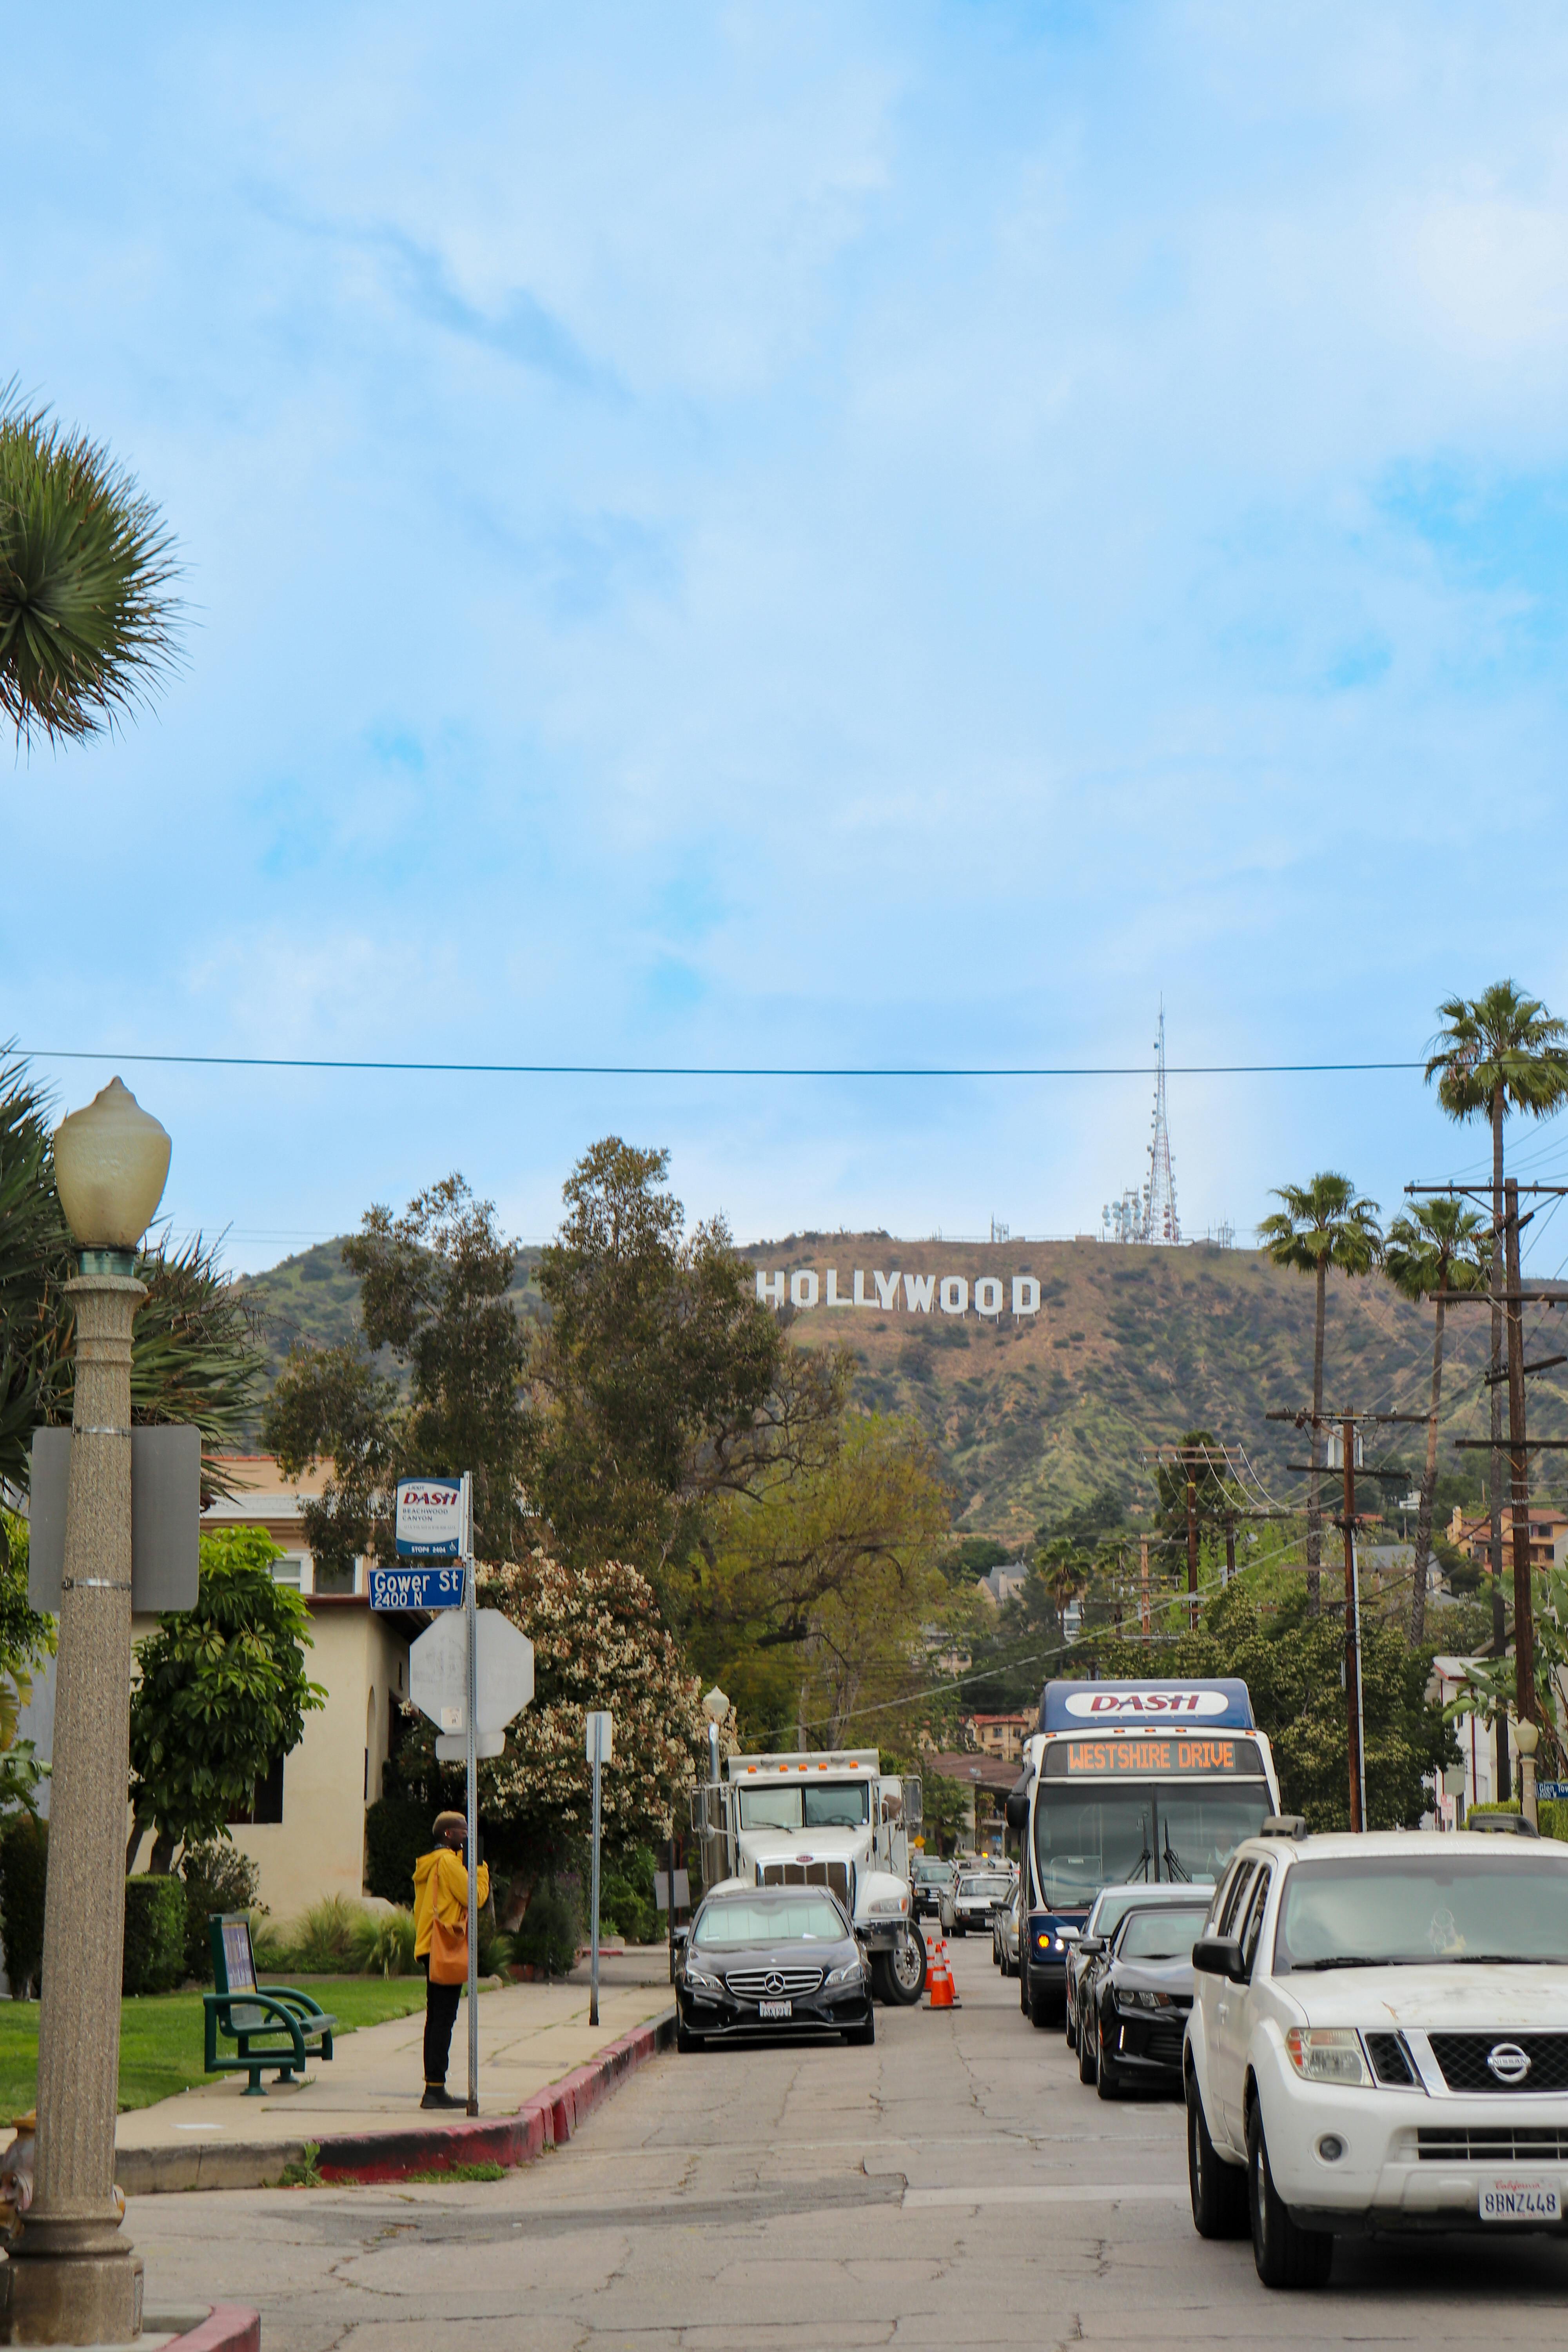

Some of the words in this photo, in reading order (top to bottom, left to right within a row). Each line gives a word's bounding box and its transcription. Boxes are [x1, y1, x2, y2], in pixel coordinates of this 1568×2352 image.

[756, 1269, 1041, 1316] HOLLYWOOD
[403, 1492, 457, 1505] DASH
[375, 1570, 430, 1593] Gower
[439, 1570, 459, 1592] St
[375, 1592, 408, 1607] 2400
[414, 1591, 422, 1606] N
[1091, 1695, 1200, 1711] DASH
[1069, 1743, 1171, 1769] WESTSHIRE
[1178, 1742, 1234, 1768] DRIVE
[1539, 1783, 1554, 1793] Glen
[1493, 2057, 1527, 2066] NISSAN
[1495, 2179, 1541, 2192] California
[1485, 2192, 1556, 2212] 8BNZ448
